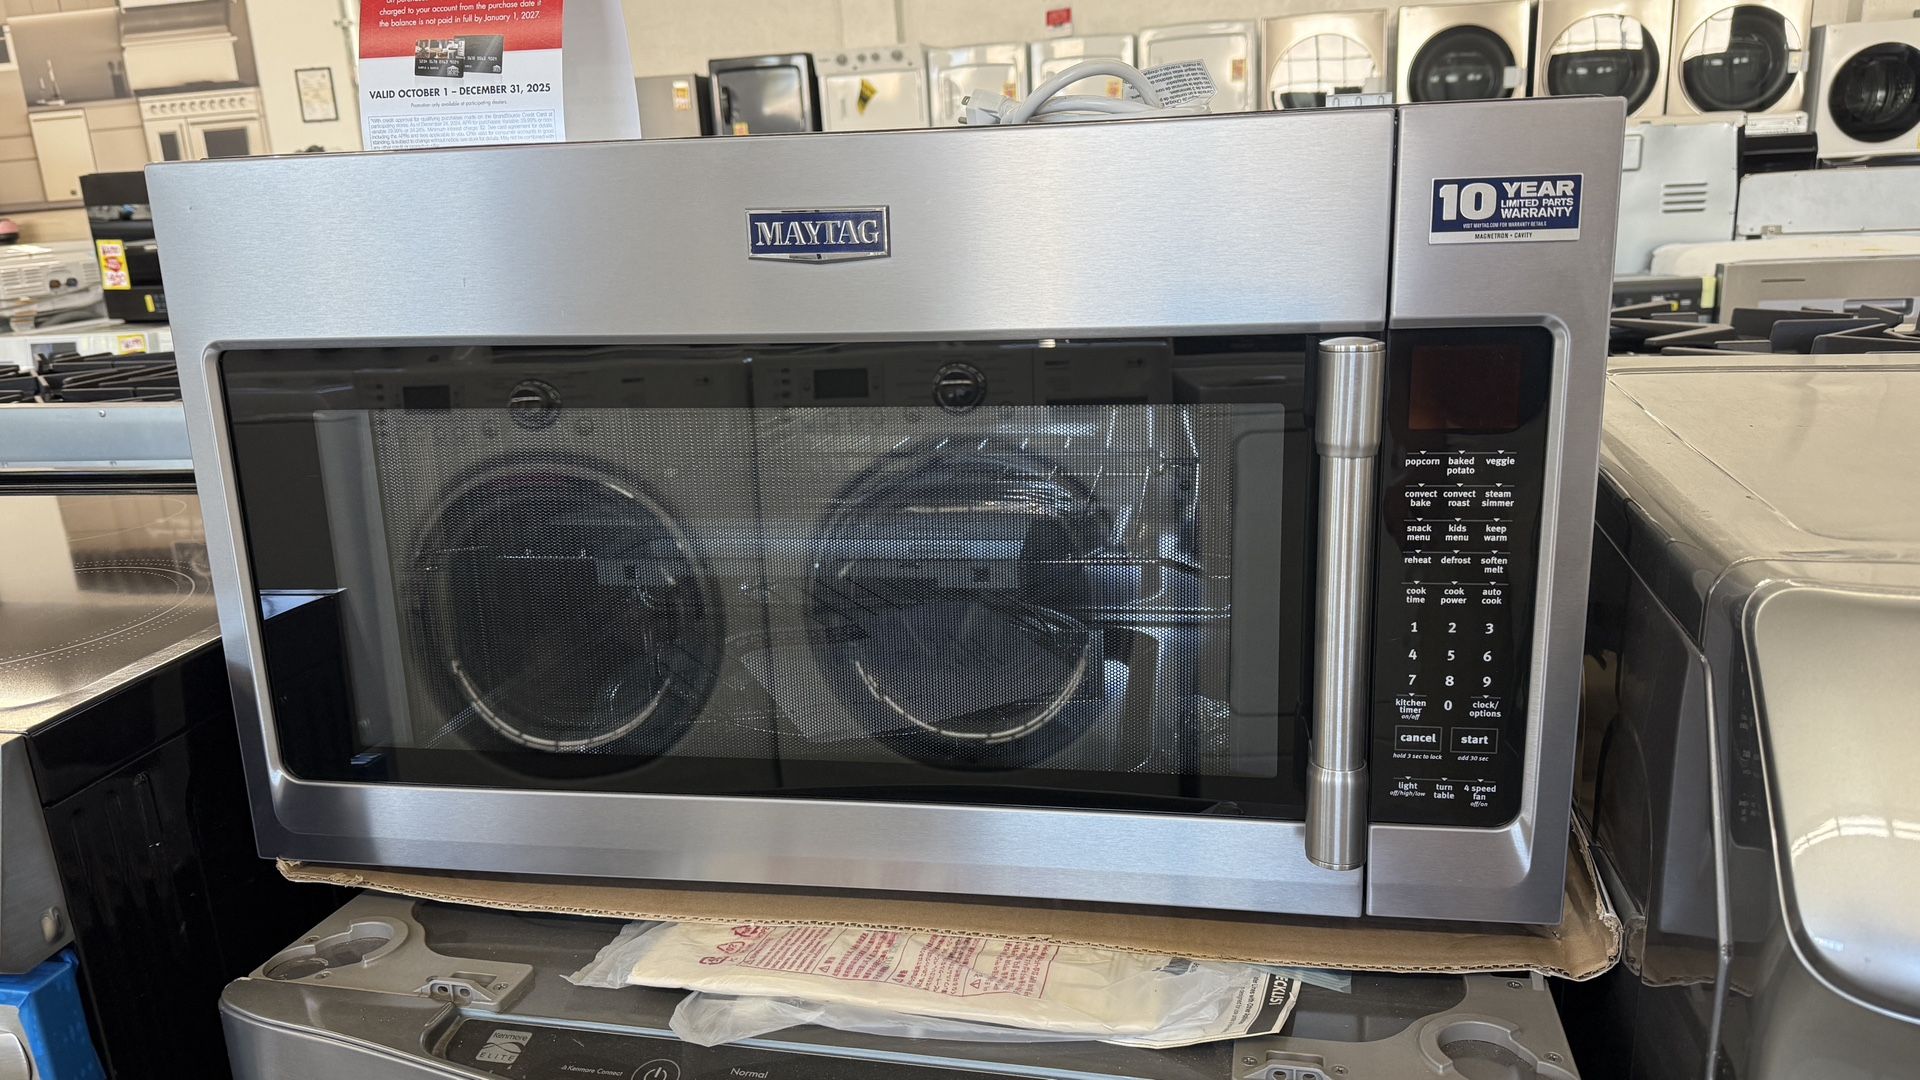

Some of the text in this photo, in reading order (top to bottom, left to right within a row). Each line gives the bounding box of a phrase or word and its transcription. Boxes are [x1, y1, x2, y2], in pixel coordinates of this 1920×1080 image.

[379, 7, 406, 17] charged
[415, 7, 430, 15] your
[488, 1, 517, 11] purchase
[437, 16, 453, 26] paid
[454, 15, 461, 23] in
[462, 14, 472, 22] full
[474, 14, 482, 24] by
[483, 12, 510, 23] January
[513, 12, 519, 21] 1,
[520, 11, 541, 20] 2027.
[369, 90, 395, 100] VALID
[398, 88, 440, 98] OCTOBER
[443, 88, 448, 96] 1
[459, 84, 507, 96] DECEMBER
[510, 84, 524, 95] 31,
[527, 83, 551, 94] 2025
[1439, 180, 1575, 221] 10 YEAR
[1501, 198, 1574, 208] LIMITED PARTS
[1501, 207, 1573, 219] WARRANTY
[754, 220, 880, 246] MAYTAG
[1405, 458, 1440, 467] popcorn
[1448, 457, 1474, 465] baked
[1486, 457, 1515, 467] veggie
[1447, 467, 1475, 476] potato
[1486, 525, 1506, 534] keep
[1406, 595, 1425, 604] time
[1440, 596, 1467, 605] power
[1411, 622, 1418, 632] 1
[1448, 622, 1456, 633] 2
[1485, 623, 1494, 634] 3
[1408, 649, 1417, 660] 4
[1447, 650, 1455, 661] 5
[1483, 651, 1492, 662] 6
[1408, 674, 1416, 685] 7
[1445, 676, 1454, 686] 8
[1482, 676, 1491, 687] 9
[1396, 698, 1426, 707] kitchen
[1444, 700, 1452, 711] 0
[1472, 701, 1499, 710] clock/
[1469, 710, 1501, 718] options
[1400, 733, 1436, 743] cancel
[1461, 735, 1488, 745] start
[1398, 781, 1418, 791] light
[1471, 785, 1496, 794] speed
[1473, 792, 1486, 800] fan
[492, 1031, 529, 1042] Kenmore
[479, 1052, 516, 1063] ELITE
[567, 1065, 623, 1076] Kenmore Connect
[730, 1068, 769, 1079] Normal
